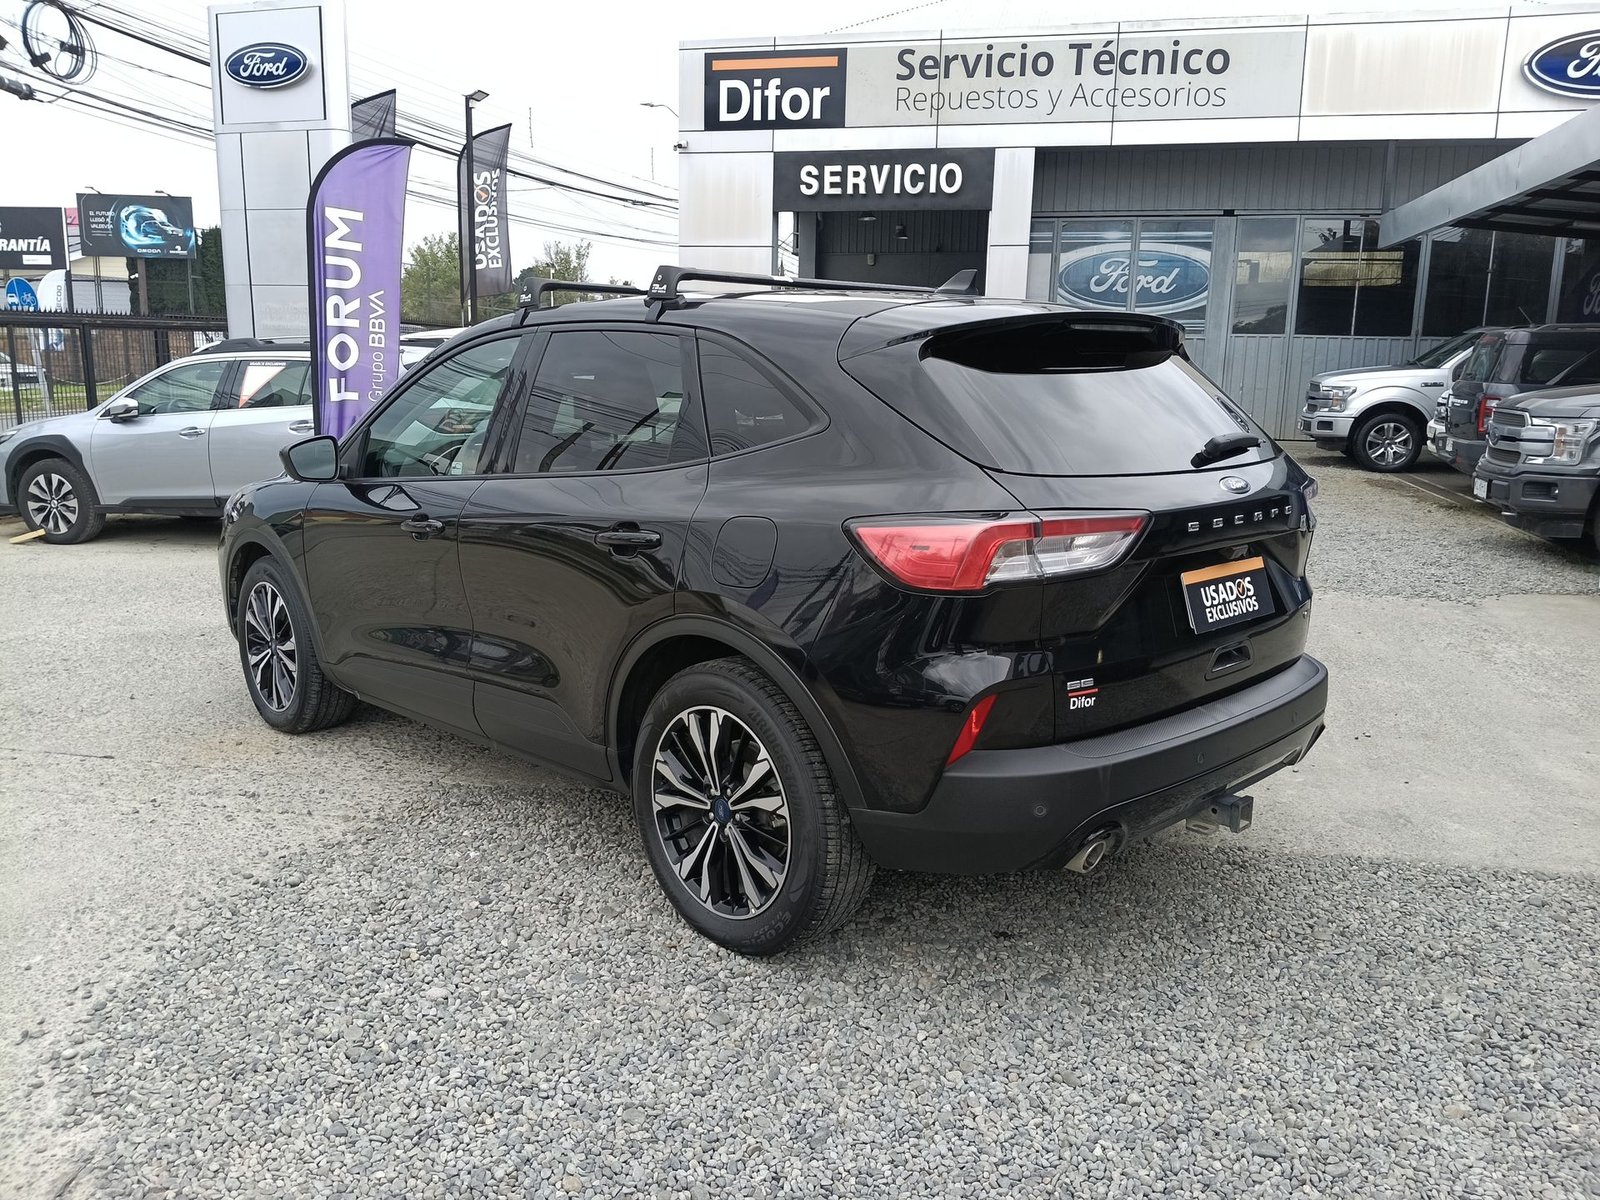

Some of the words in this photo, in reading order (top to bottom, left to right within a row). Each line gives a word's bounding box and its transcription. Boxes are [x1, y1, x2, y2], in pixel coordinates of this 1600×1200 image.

[239, 51, 287, 78] Ford
[896, 43, 1054, 81] Servicio
[1068, 39, 1231, 77] Técnico
[718, 78, 830, 121] Difor
[896, 85, 1039, 116] Repuestos
[1046, 88, 1061, 114] y
[1070, 82, 1227, 108] Accesorios
[799, 162, 964, 196] SERVICIO
[473, 171, 492, 270] USADOS
[1089, 258, 1179, 294] Ford
[324, 206, 364, 402] FORUM
[367, 289, 387, 350] BBVA
[367, 351, 387, 402] Grupo
[1187, 504, 1293, 533] ESCAPE
[1200, 576, 1255, 607] USADOS
[1205, 596, 1259, 623] EXCLUSIVOS
[1069, 696, 1096, 710] Difor
